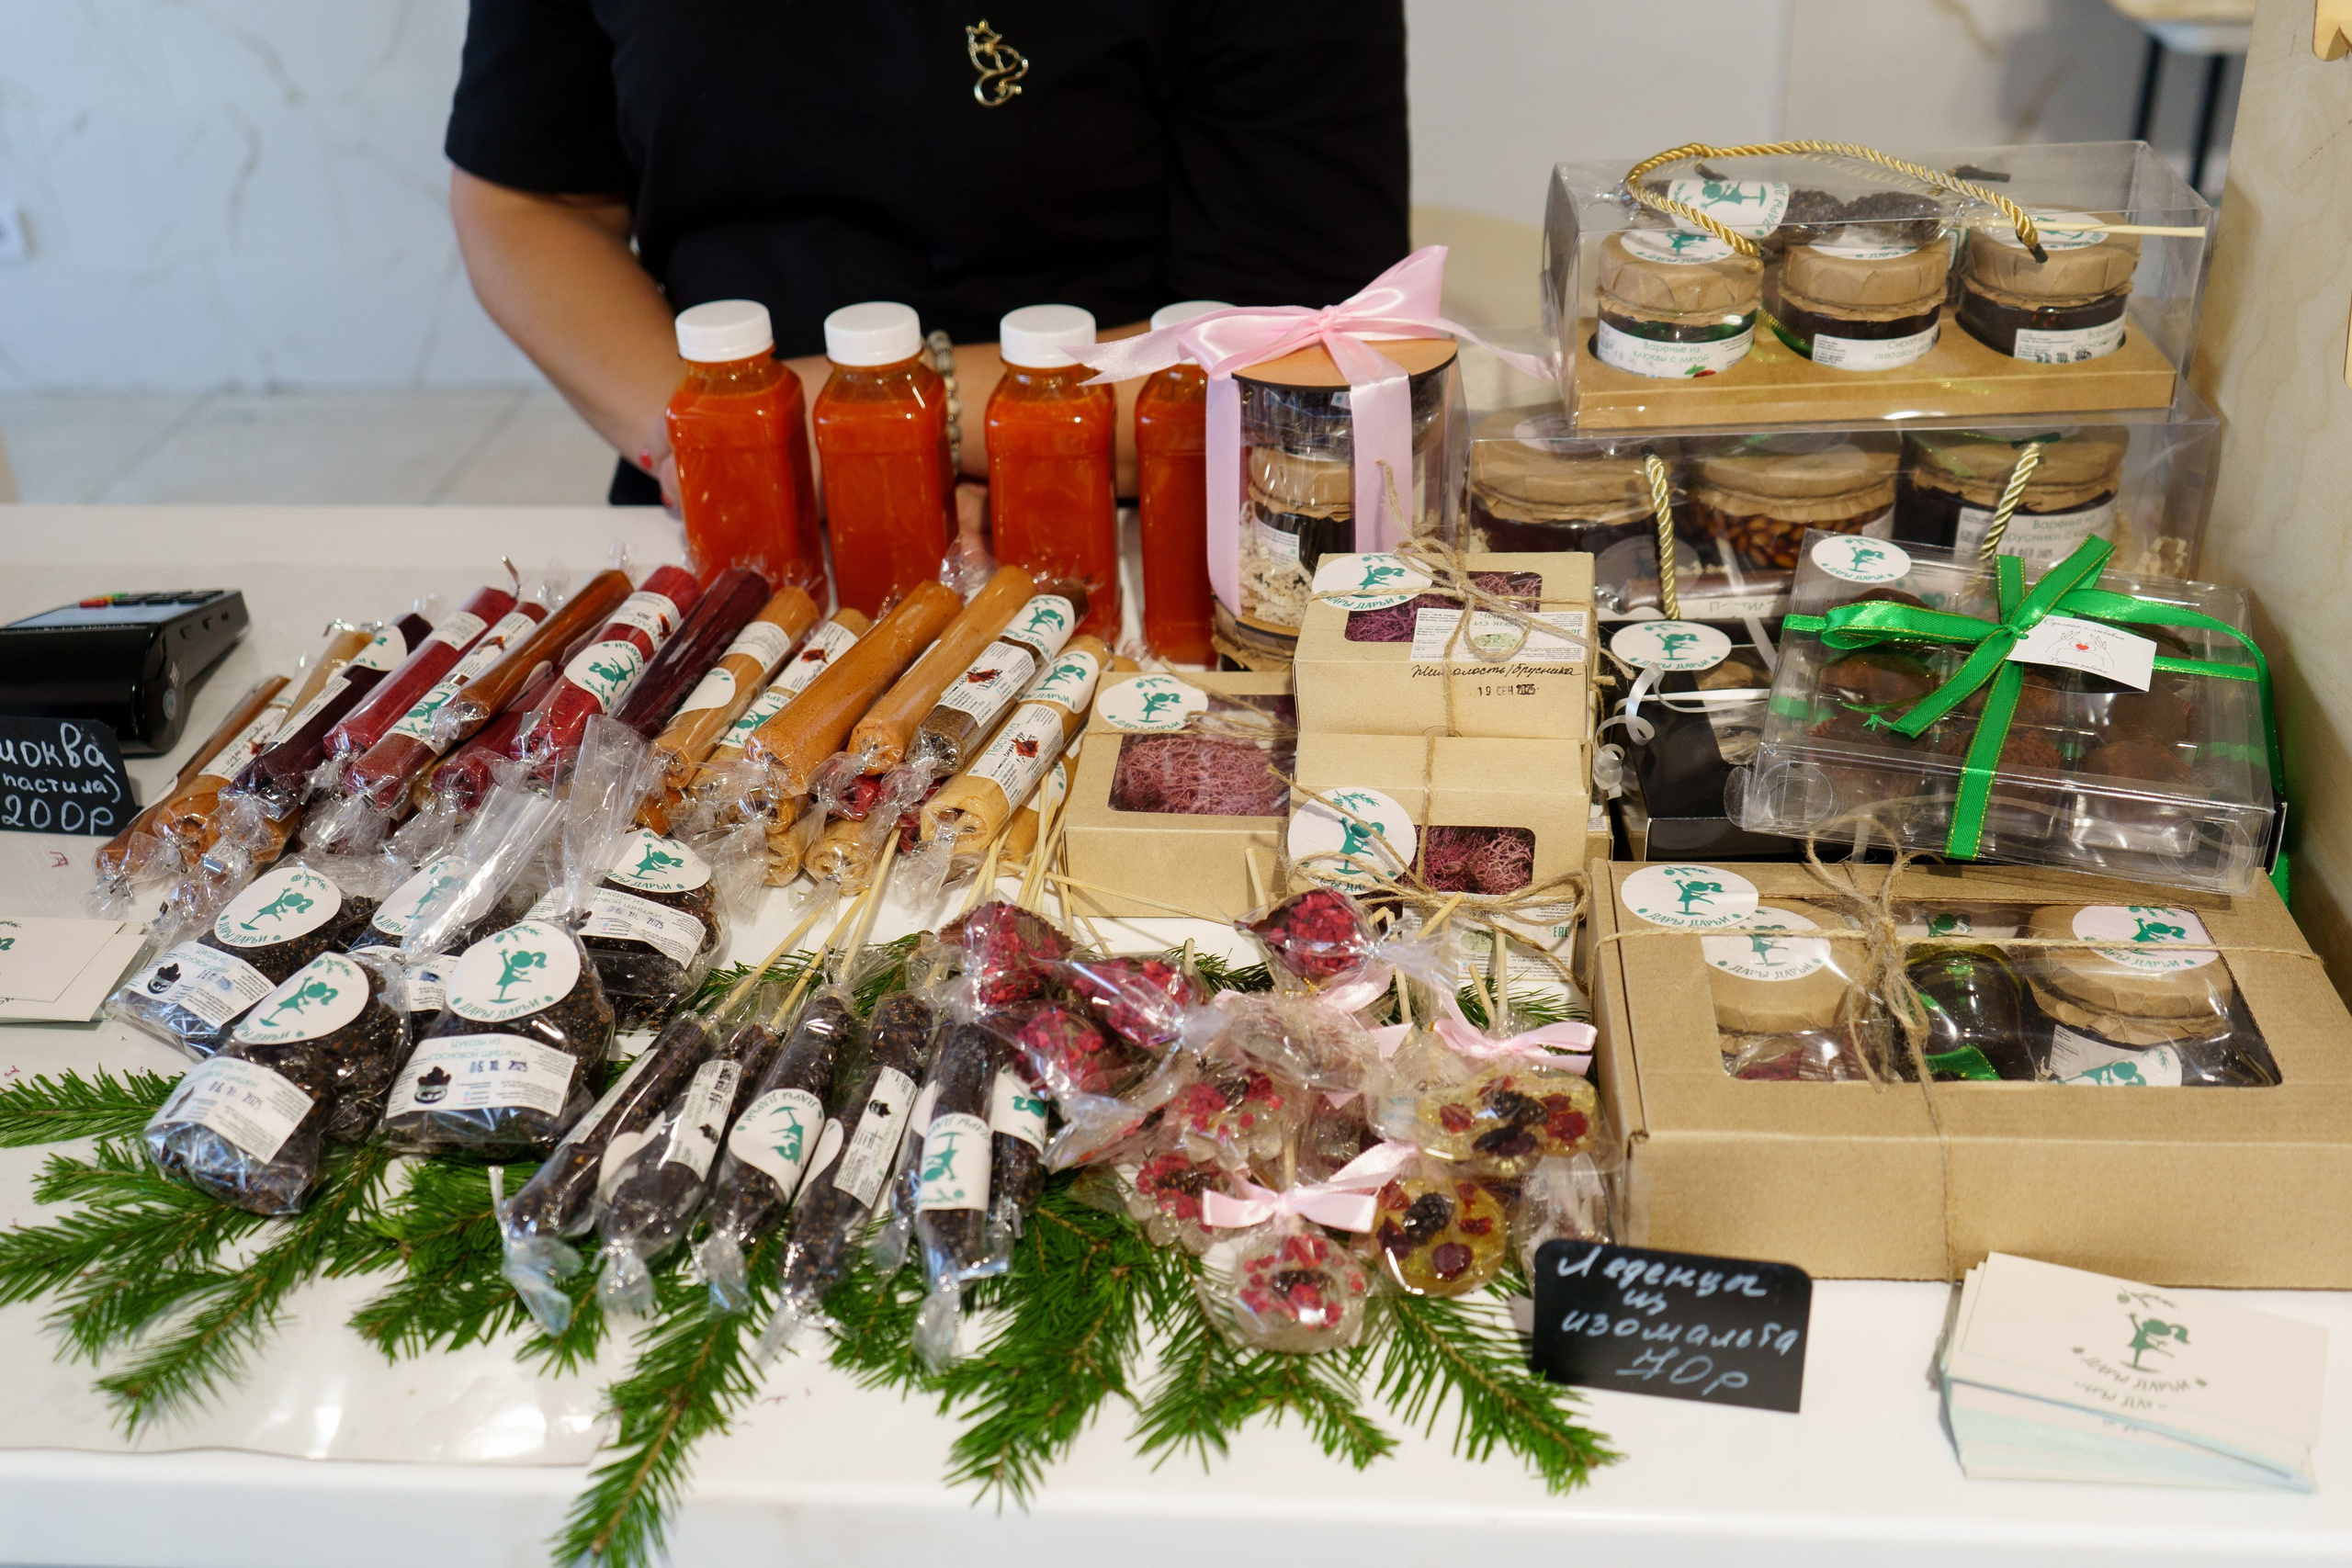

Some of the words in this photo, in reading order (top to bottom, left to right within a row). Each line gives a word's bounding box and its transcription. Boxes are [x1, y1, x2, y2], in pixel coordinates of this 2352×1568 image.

[1762, 198, 1784, 231] ДАРЫ
[1644, 341, 1687, 354] Варенье
[1887, 337, 1917, 349] Сироп
[1633, 351, 1668, 362] клюквы
[1679, 354, 1710, 364] мятой
[1874, 349, 1915, 361] пихтовой
[2032, 518, 2082, 531] Варенье
[1826, 567, 1853, 579] ДАРЫ
[1854, 573, 1886, 581] ДАРЬИ
[1353, 597, 1395, 610] ДАРЬИ
[2043, 617, 2081, 629] Сделано
[2091, 627, 2126, 641] любовью
[615, 642, 643, 664] ДАРЬИ
[1676, 659, 1711, 670] ДАРЬИ
[2049, 655, 2079, 667] Ручная
[2080, 662, 2109, 675] работа
[1476, 685, 1492, 697] 19
[1496, 685, 1514, 696] СЕН
[1037, 694, 1071, 705] ДАРЬИ
[985, 722, 1021, 756] Пастила
[1, 794, 114, 835] 200р
[631, 880, 672, 890] ДАРЬИ
[624, 902, 662, 919] шишки
[377, 919, 408, 933] ДАРЫ
[646, 917, 665, 930] 2025
[1647, 912, 1685, 927] ДАРЫ
[1688, 915, 1731, 928] ДАРЬИ
[218, 920, 235, 941] ДАРЫ
[229, 934, 268, 945] ДАРЬИ
[196, 946, 220, 962] Цукаты
[175, 952, 209, 968] сосновой
[209, 963, 230, 974] шишки
[1727, 964, 1770, 979] ДАРЫ
[1774, 962, 1814, 980] ДАРЬИ
[2131, 958, 2181, 968] ДАРЬИ
[458, 1002, 493, 1019] ДАРЫ
[493, 998, 540, 1020] ДАРЬИ
[250, 1031, 290, 1042] ДАРЬИ
[449, 1038, 487, 1049] Цукаты
[488, 1038, 502, 1046] из
[427, 1049, 479, 1061] сосновой
[508, 1060, 528, 1073] 2025
[242, 1091, 263, 1111] 2025
[743, 1093, 778, 1122] ДАРЬИ
[782, 1091, 820, 1108] ДАРЫ
[1622, 1289, 1668, 1316] из
[1561, 1309, 1800, 1357] изомальта
[2080, 1357, 2131, 1384] ДАРЫ
[2133, 1378, 2190, 1393] ДАРЬИ
